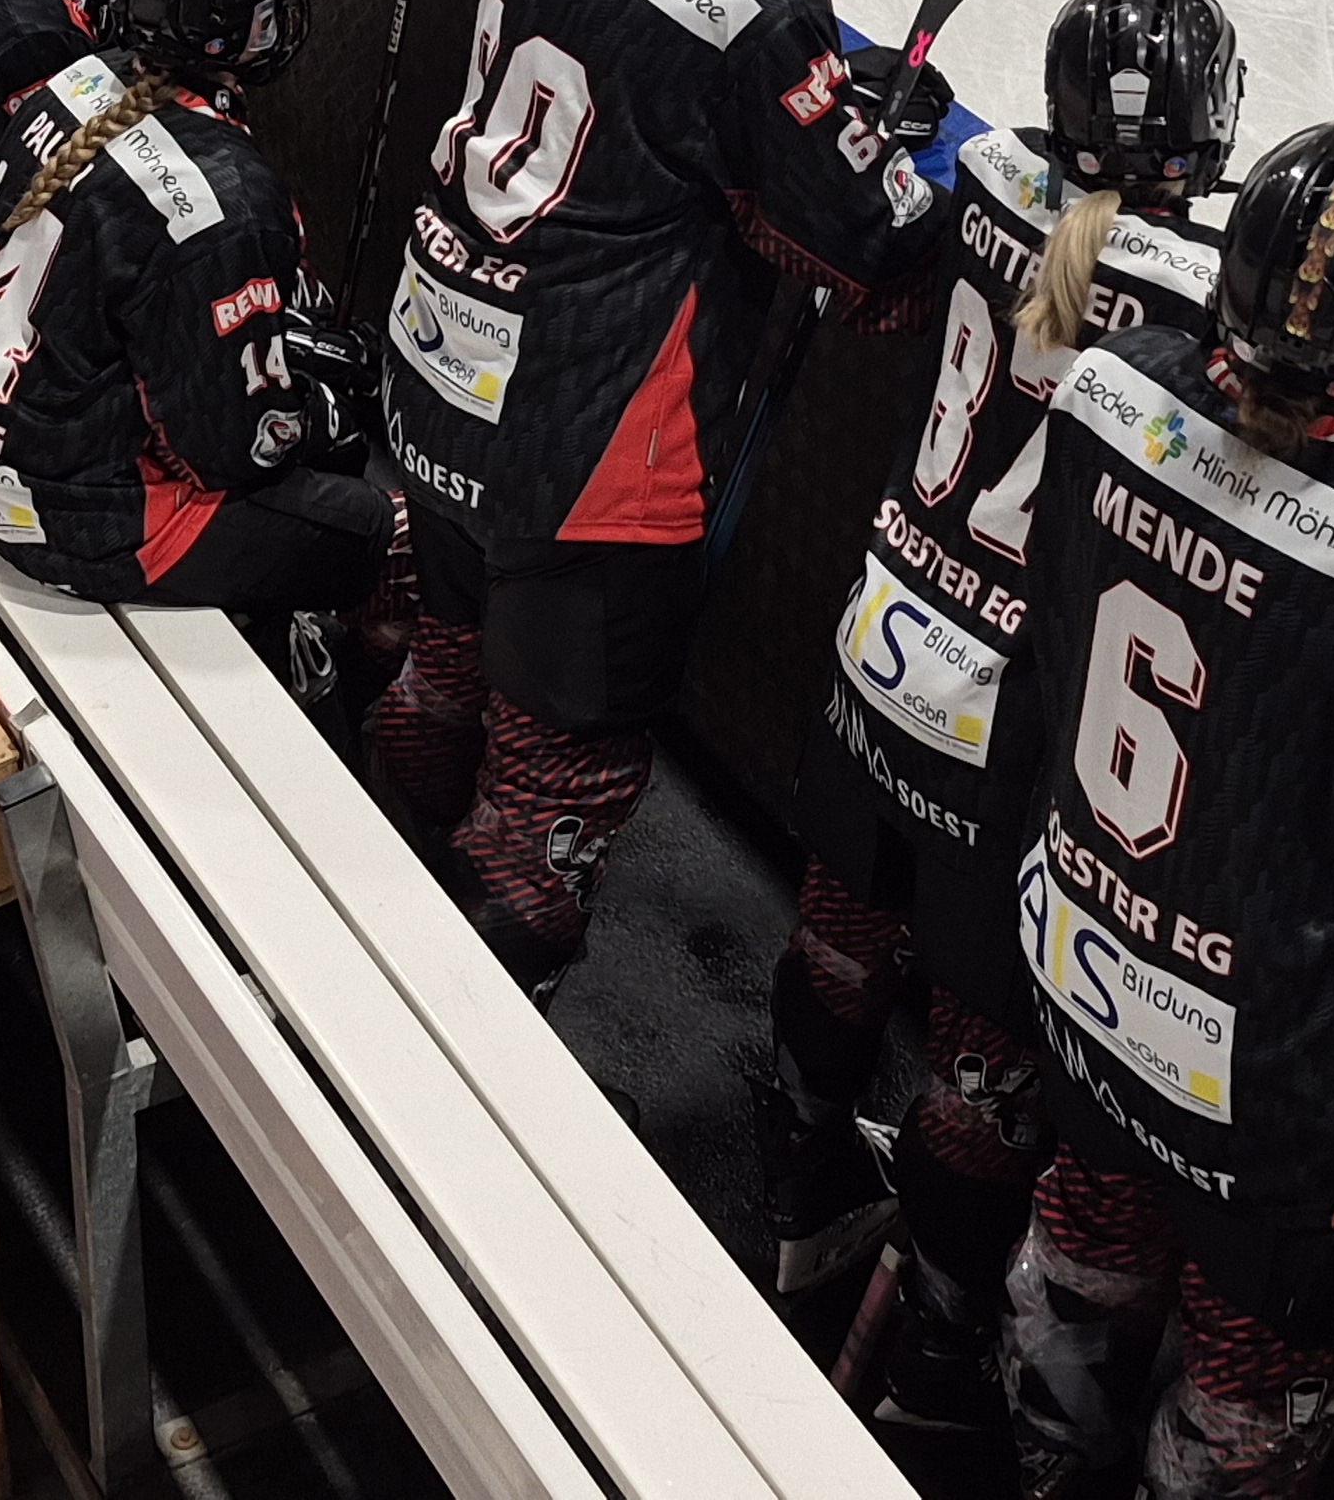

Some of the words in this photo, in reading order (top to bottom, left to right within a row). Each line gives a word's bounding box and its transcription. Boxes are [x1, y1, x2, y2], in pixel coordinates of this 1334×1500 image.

[124, 128, 194, 218] Möhnesee
[981, 143, 1021, 182] Becker
[470, 255, 529, 293] EG
[438, 293, 512, 349] Bildung
[240, 334, 292, 396] 14
[1073, 366, 1144, 429] Becker
[404, 442, 485, 509] SOEST
[1192, 447, 1262, 507] Klinik
[873, 498, 982, 609] SOESTER
[979, 584, 1028, 635] EG
[1092, 471, 1264, 619] MENDE
[923, 626, 994, 686] Bildung
[903, 691, 948, 728] eGbR
[1074, 579, 1207, 860] 6
[896, 778, 980, 847] SOEST
[1047, 805, 1159, 943] OESTER
[1171, 913, 1234, 976] EG
[1122, 962, 1223, 1045] Bildung
[1126, 1036, 1180, 1082] eGbR
[1130, 1117, 1236, 1201] SOEST
